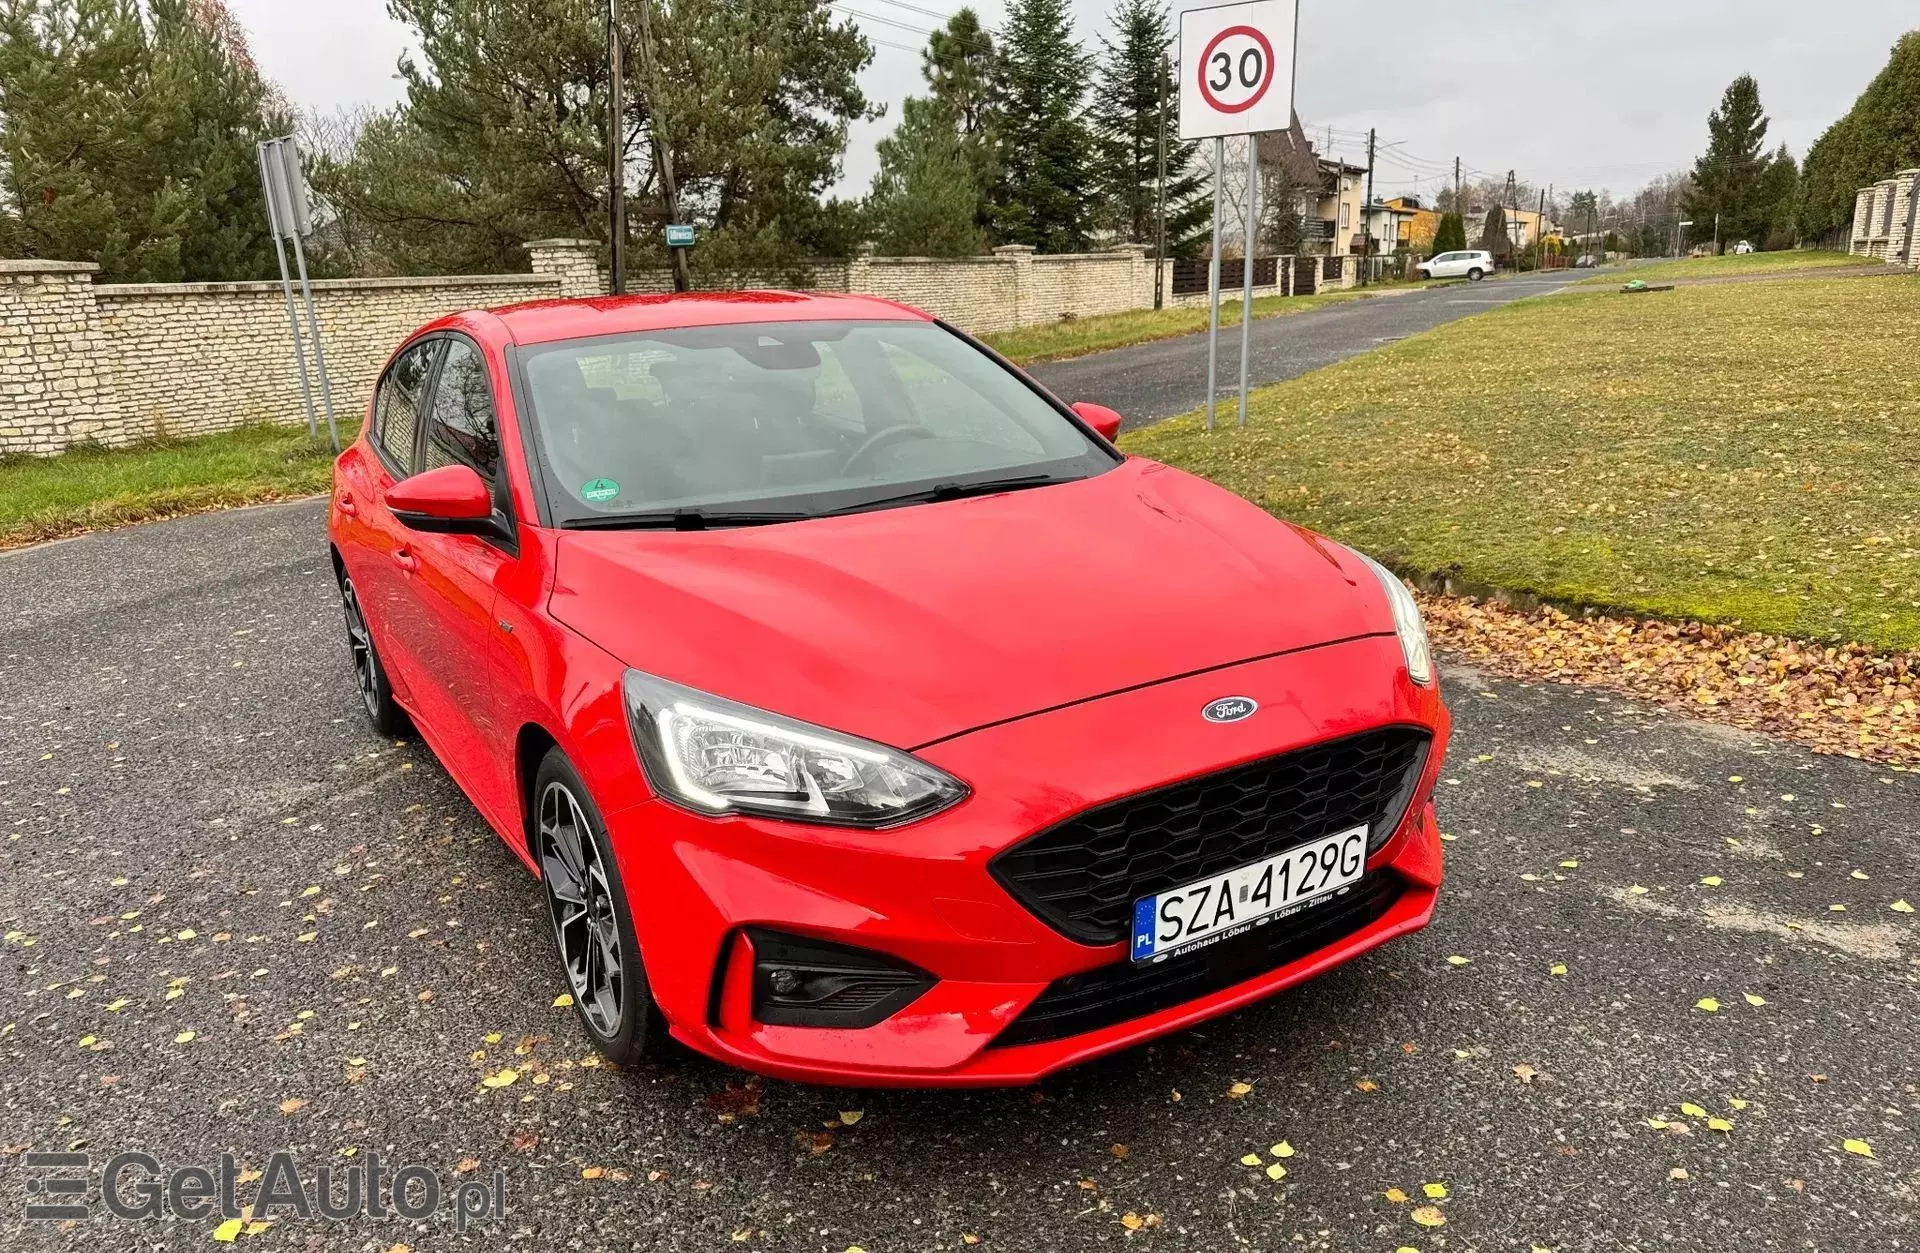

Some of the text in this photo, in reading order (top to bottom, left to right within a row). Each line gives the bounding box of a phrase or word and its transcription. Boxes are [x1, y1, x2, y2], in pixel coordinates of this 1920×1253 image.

[1209, 48, 1262, 91] 30
[1216, 702, 1246, 718] Ford
[1159, 834, 1361, 942] SZA 4129G
[1136, 933, 1152, 948] PL
[1174, 936, 1221, 957] Autohaus
[1222, 924, 1251, 940] Löbau
[1274, 905, 1301, 920] Löbau
[1308, 893, 1333, 908] Zittau
